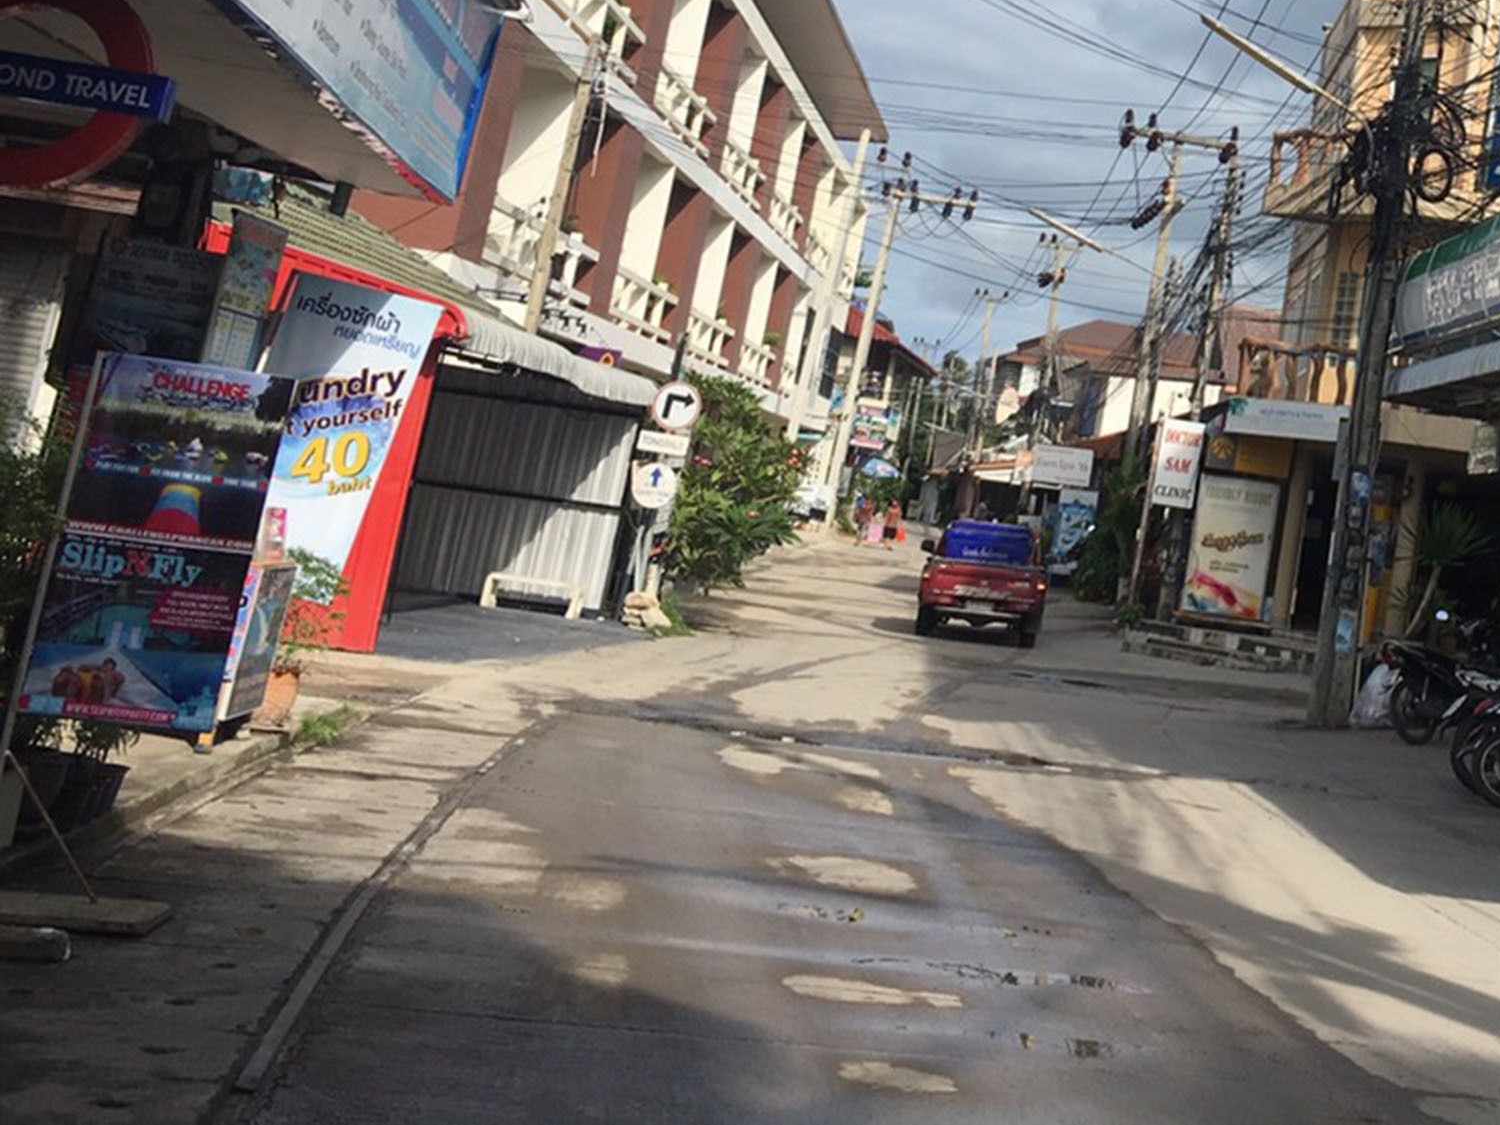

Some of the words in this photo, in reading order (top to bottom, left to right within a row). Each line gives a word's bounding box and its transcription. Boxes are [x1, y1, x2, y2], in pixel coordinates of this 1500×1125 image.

[64, 72, 151, 109] TRAVEL
[153, 369, 252, 401] CHALLENGE
[299, 367, 408, 404] undry
[302, 399, 404, 438] yourself
[290, 430, 371, 485] 40
[1163, 456, 1193, 474] SAM
[327, 476, 372, 497] baht
